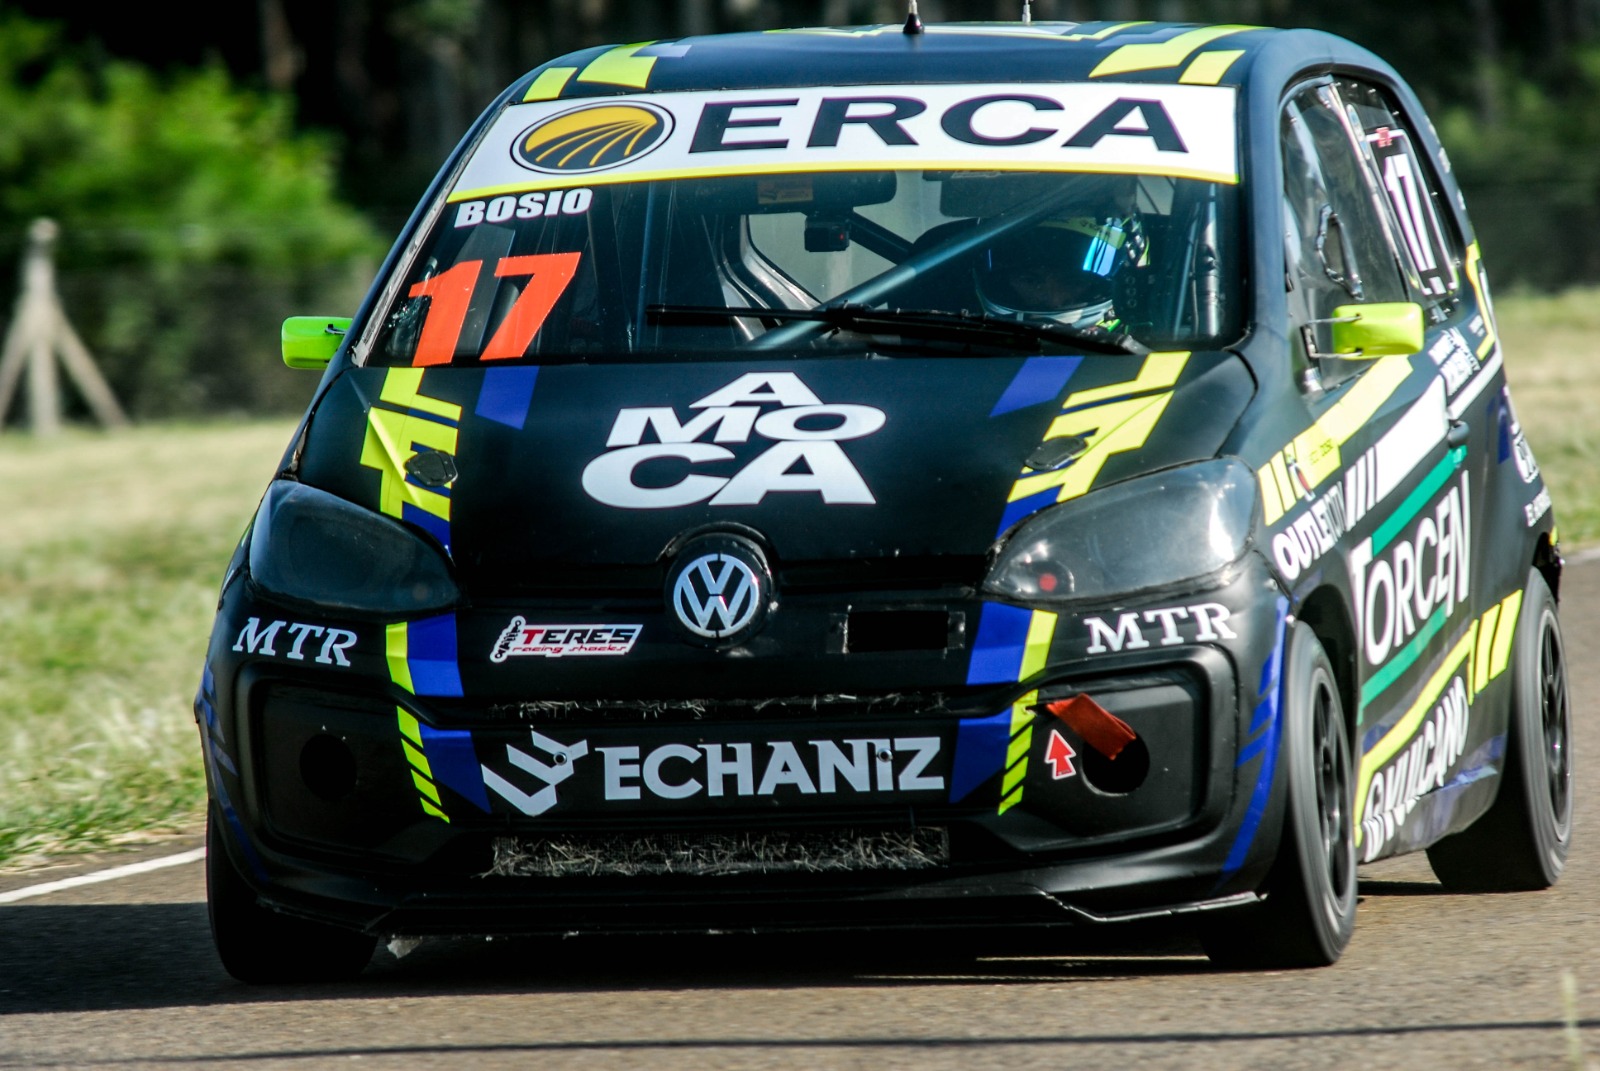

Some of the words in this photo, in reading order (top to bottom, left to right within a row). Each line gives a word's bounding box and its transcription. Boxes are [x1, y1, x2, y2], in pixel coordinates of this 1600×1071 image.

[689, 94, 1189, 153] ERCA
[454, 188, 593, 228] BOSIO
[1384, 153, 1437, 271] 17
[408, 252, 581, 367] 17
[1350, 469, 1471, 665] TORCEN
[232, 617, 358, 667] MTR
[512, 646, 563, 654] racing
[522, 628, 637, 645] TERES
[1083, 603, 1237, 654] MTR
[595, 736, 945, 801] ECHANIZ
